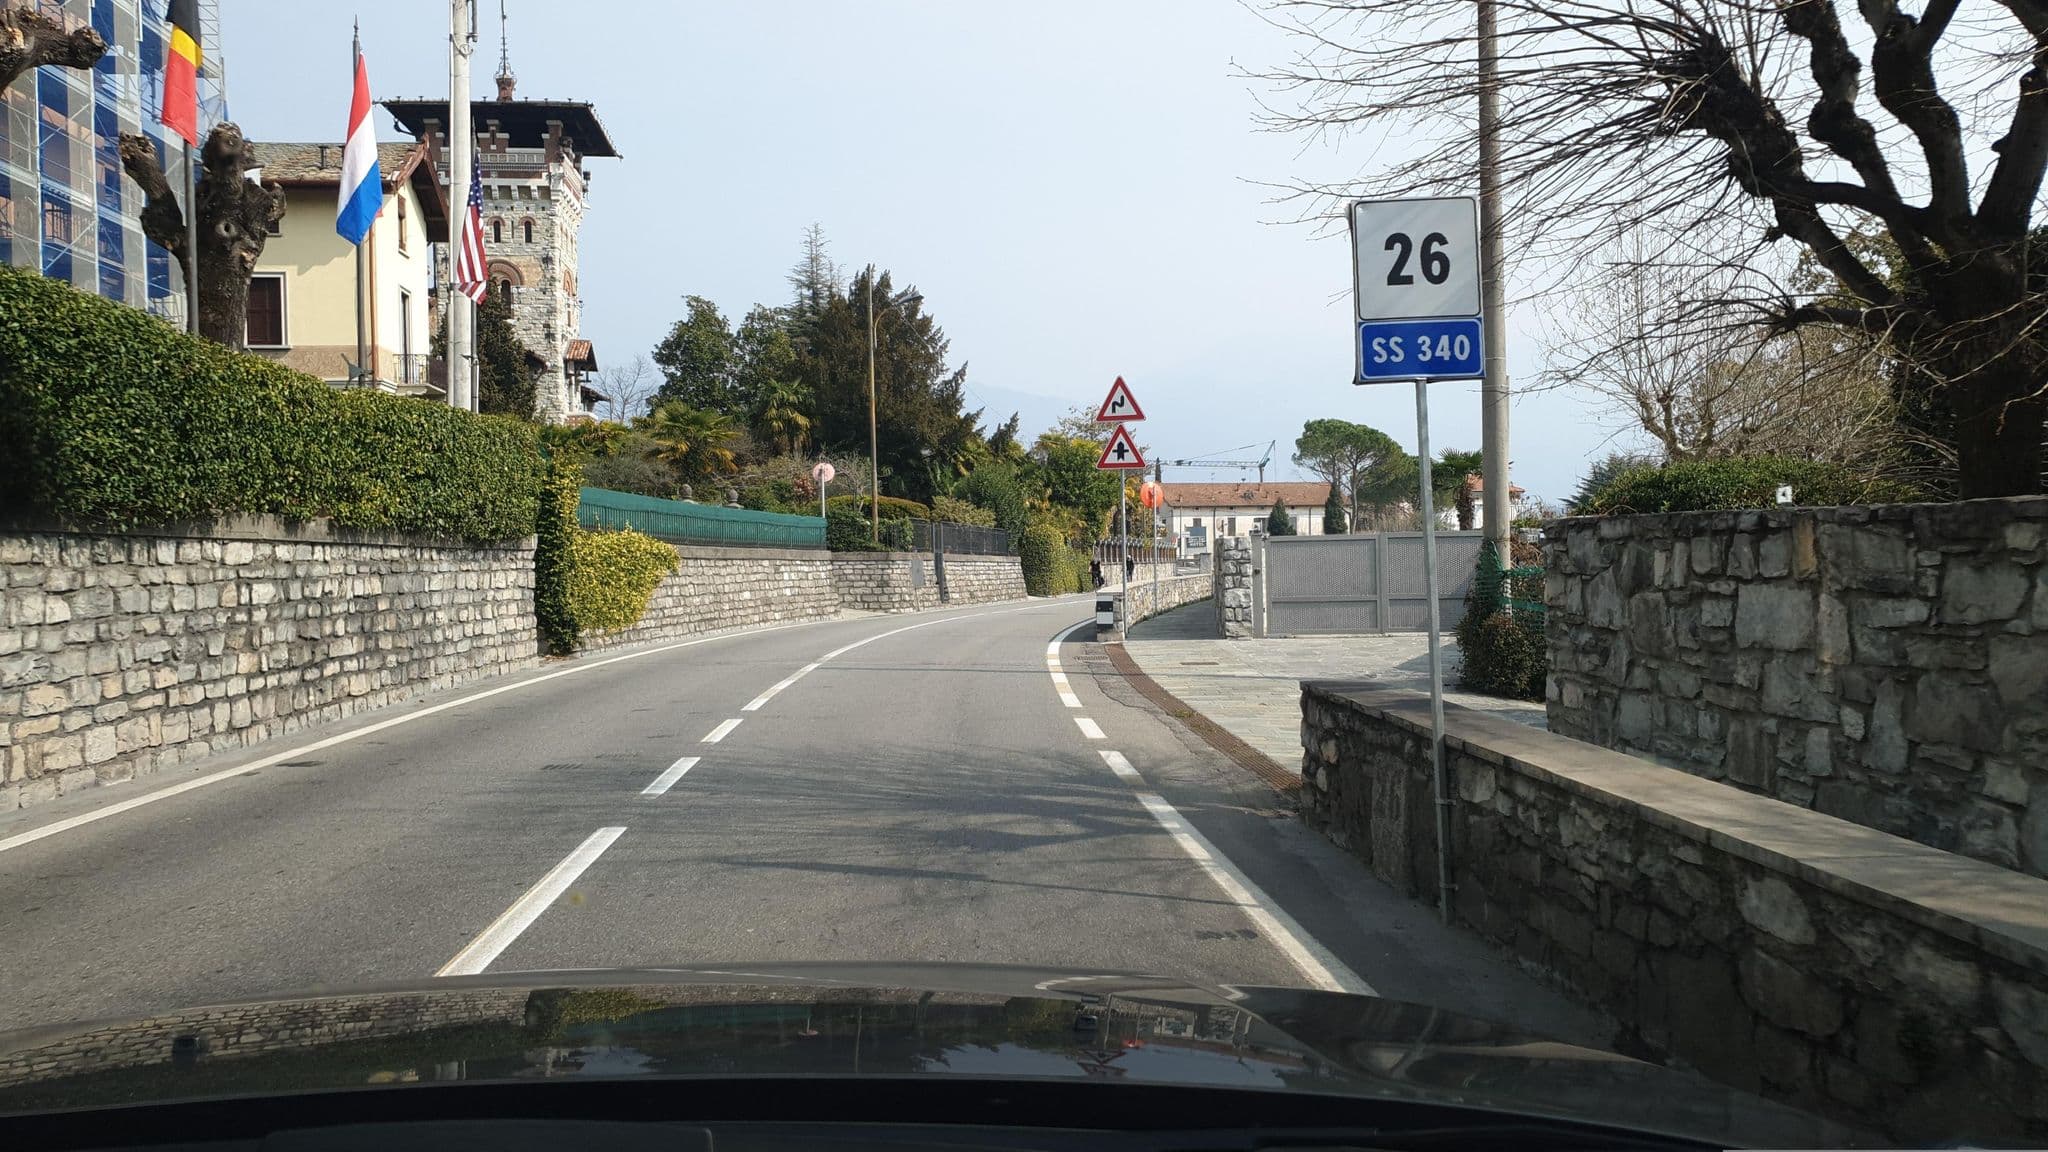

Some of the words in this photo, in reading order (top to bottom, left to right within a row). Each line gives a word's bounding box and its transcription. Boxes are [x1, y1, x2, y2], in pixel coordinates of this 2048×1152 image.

[1384, 232, 1450, 286] 26
[1372, 336, 1405, 363] SS
[1417, 334, 1471, 362] 340
